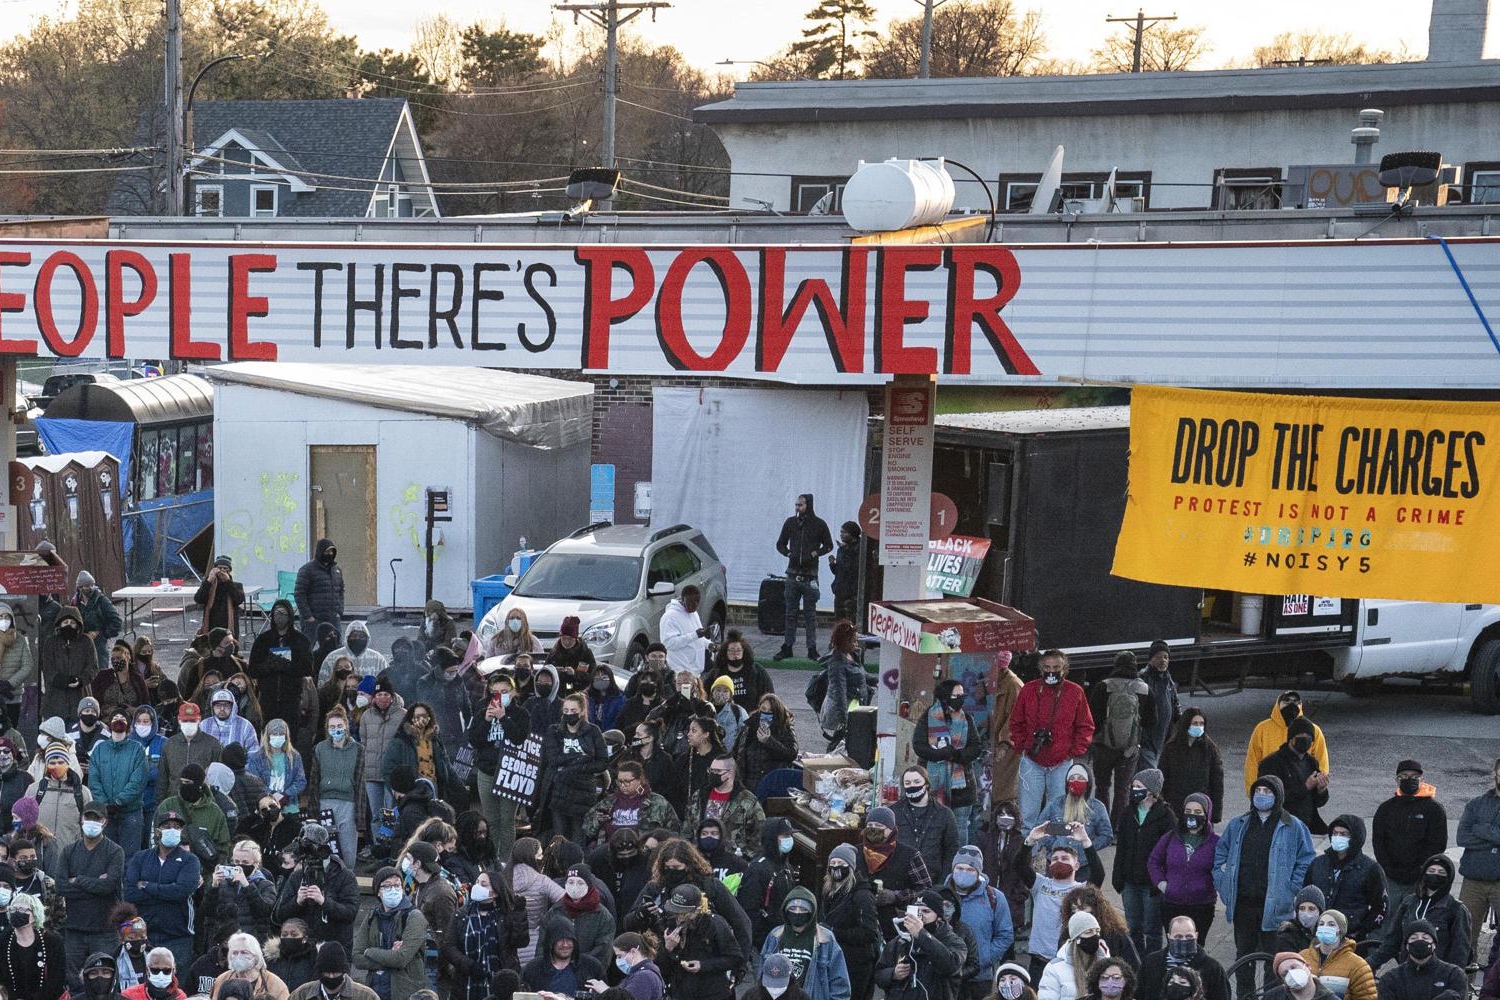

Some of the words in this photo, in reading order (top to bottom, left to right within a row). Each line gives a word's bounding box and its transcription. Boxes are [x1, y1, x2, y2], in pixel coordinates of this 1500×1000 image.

[297, 260, 557, 354] THERE'S
[574, 245, 1041, 376] POWER
[889, 426, 915, 436] SELF
[888, 437, 924, 446] SERVE
[1171, 417, 1260, 488] DROP
[1272, 423, 1324, 491] THE
[1335, 426, 1486, 498] CHARGES
[16, 476, 25, 491] 3
[869, 508, 879, 524] 2
[937, 509, 946, 526] 1
[1173, 496, 1262, 516] PROTEST
[1279, 503, 1299, 519] IS
[1311, 504, 1349, 521] NOT
[1366, 507, 1376, 522] A
[1396, 508, 1466, 525] CRIME
[927, 553, 963, 575] LIVES
[1283, 604, 1293, 614] AS
[1293, 603, 1308, 614] ONE
[501, 756, 538, 778] GEORGE
[496, 768, 536, 796] FLOYD
